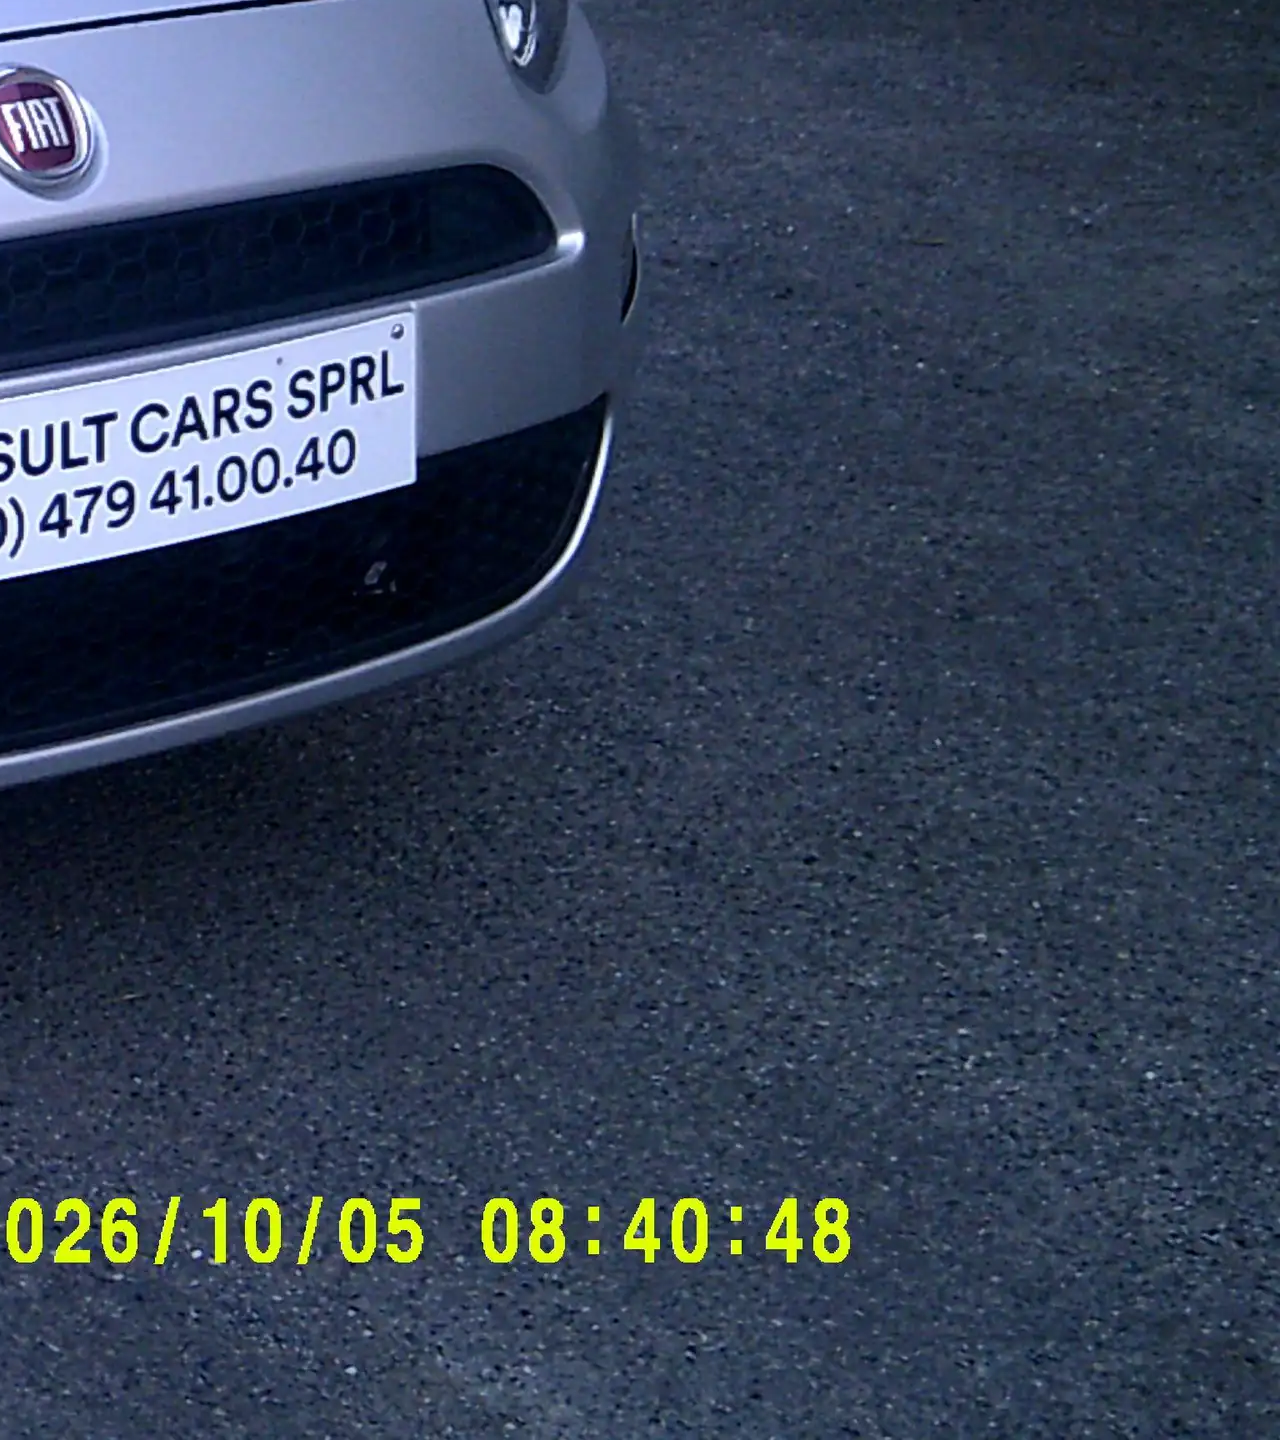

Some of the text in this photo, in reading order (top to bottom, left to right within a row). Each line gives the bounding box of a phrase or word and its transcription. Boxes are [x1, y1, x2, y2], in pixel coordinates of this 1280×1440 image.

[0, 96, 71, 154] FIAT
[129, 378, 274, 455] CARS
[286, 349, 406, 420] SPRL
[38, 478, 137, 540] 479
[148, 427, 357, 516] 41.00.40
